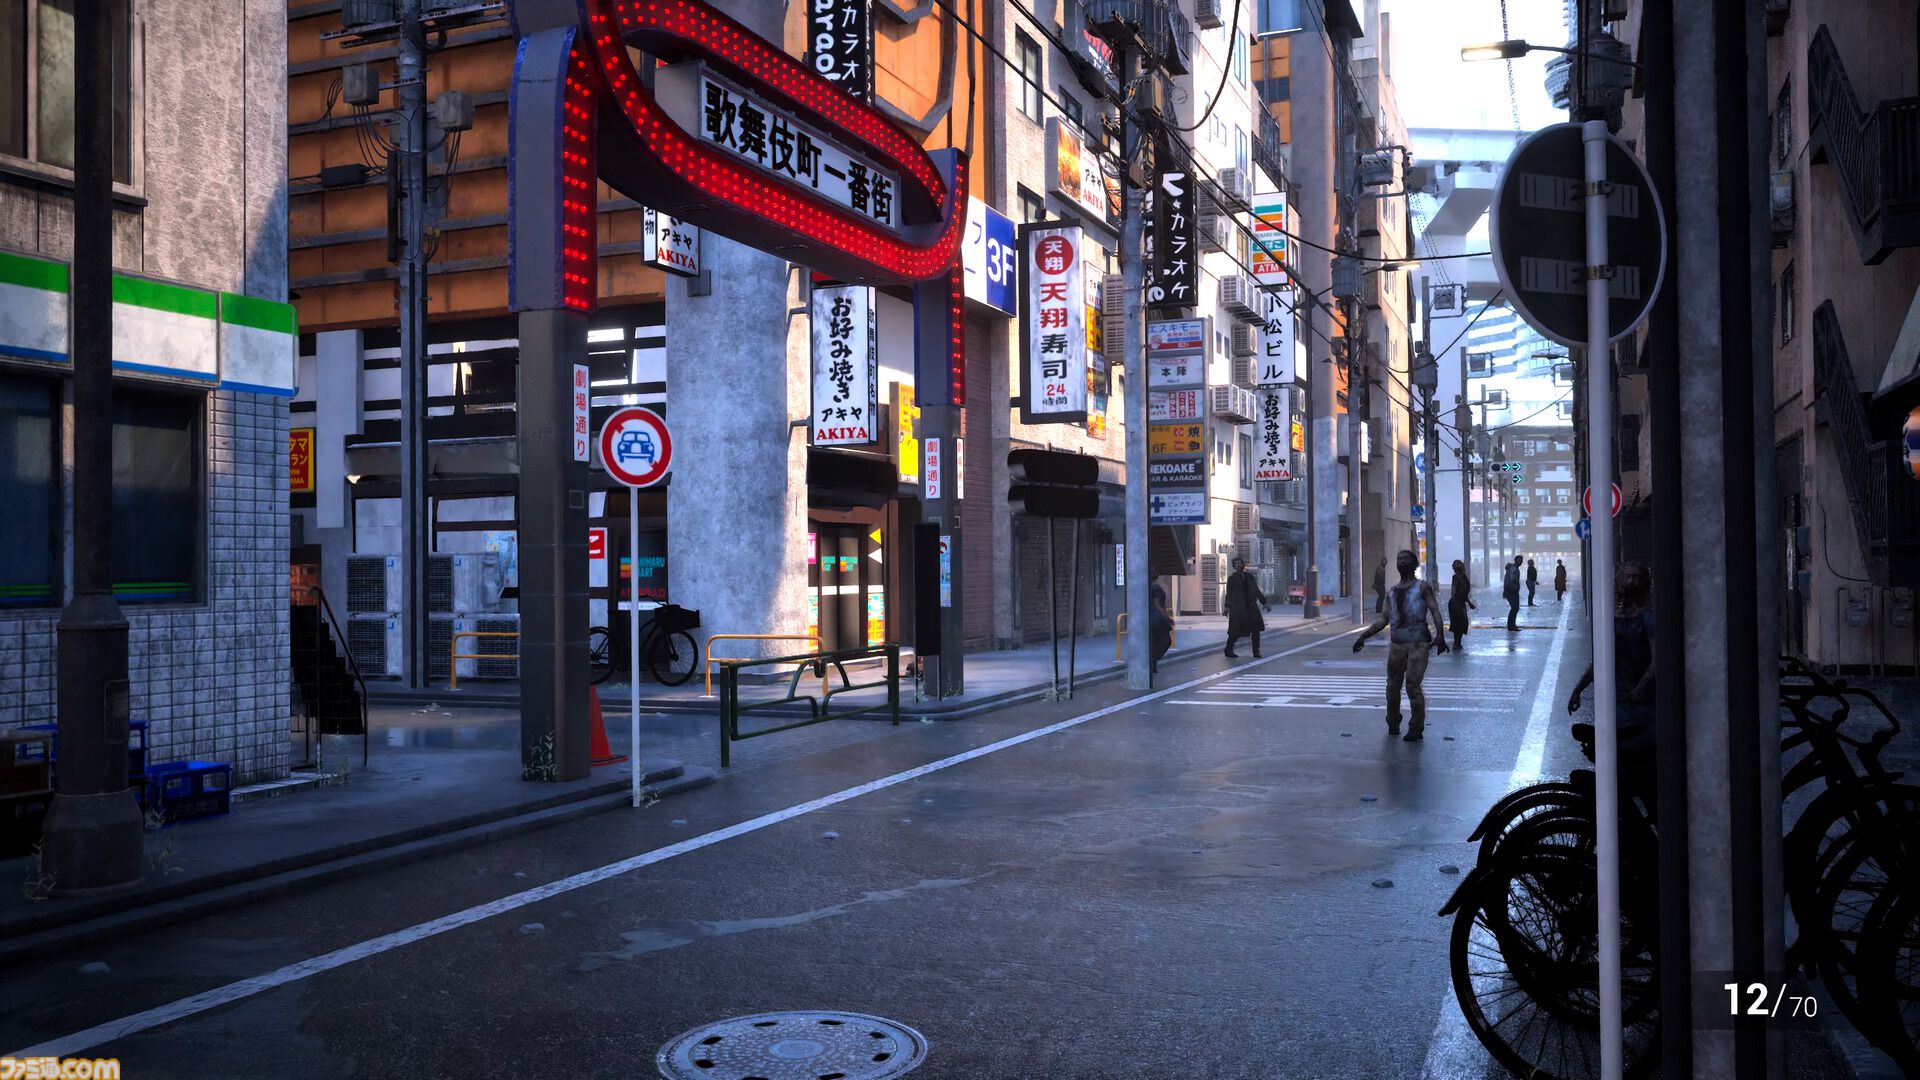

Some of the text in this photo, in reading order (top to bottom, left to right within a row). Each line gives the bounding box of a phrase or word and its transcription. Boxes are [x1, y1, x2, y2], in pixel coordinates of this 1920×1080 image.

[705, 81, 892, 225] 歌舞伎町一番街
[1083, 188, 1104, 213] AKIYA
[661, 228, 692, 250] アキヤ
[657, 246, 696, 271] AKIYA
[986, 237, 1014, 286] 3F
[1044, 240, 1064, 271] 天翔
[1171, 212, 1189, 299] カラオケ
[1258, 263, 1279, 273] ATM
[1039, 281, 1068, 379] 天翔寿司
[1262, 296, 1283, 380] 小松ビル
[829, 297, 854, 403] お好み焼き
[1042, 395, 1068, 406] 時間
[1046, 383, 1066, 396] 24
[575, 368, 587, 457] 劇場通り
[821, 407, 863, 422] アキヤ
[1264, 394, 1280, 457] お好み焼き
[816, 426, 868, 441] AKIYA
[927, 440, 938, 496] 劇場通り
[1256, 469, 1290, 478] AKIYA
[1259, 457, 1286, 468] アキヤ
